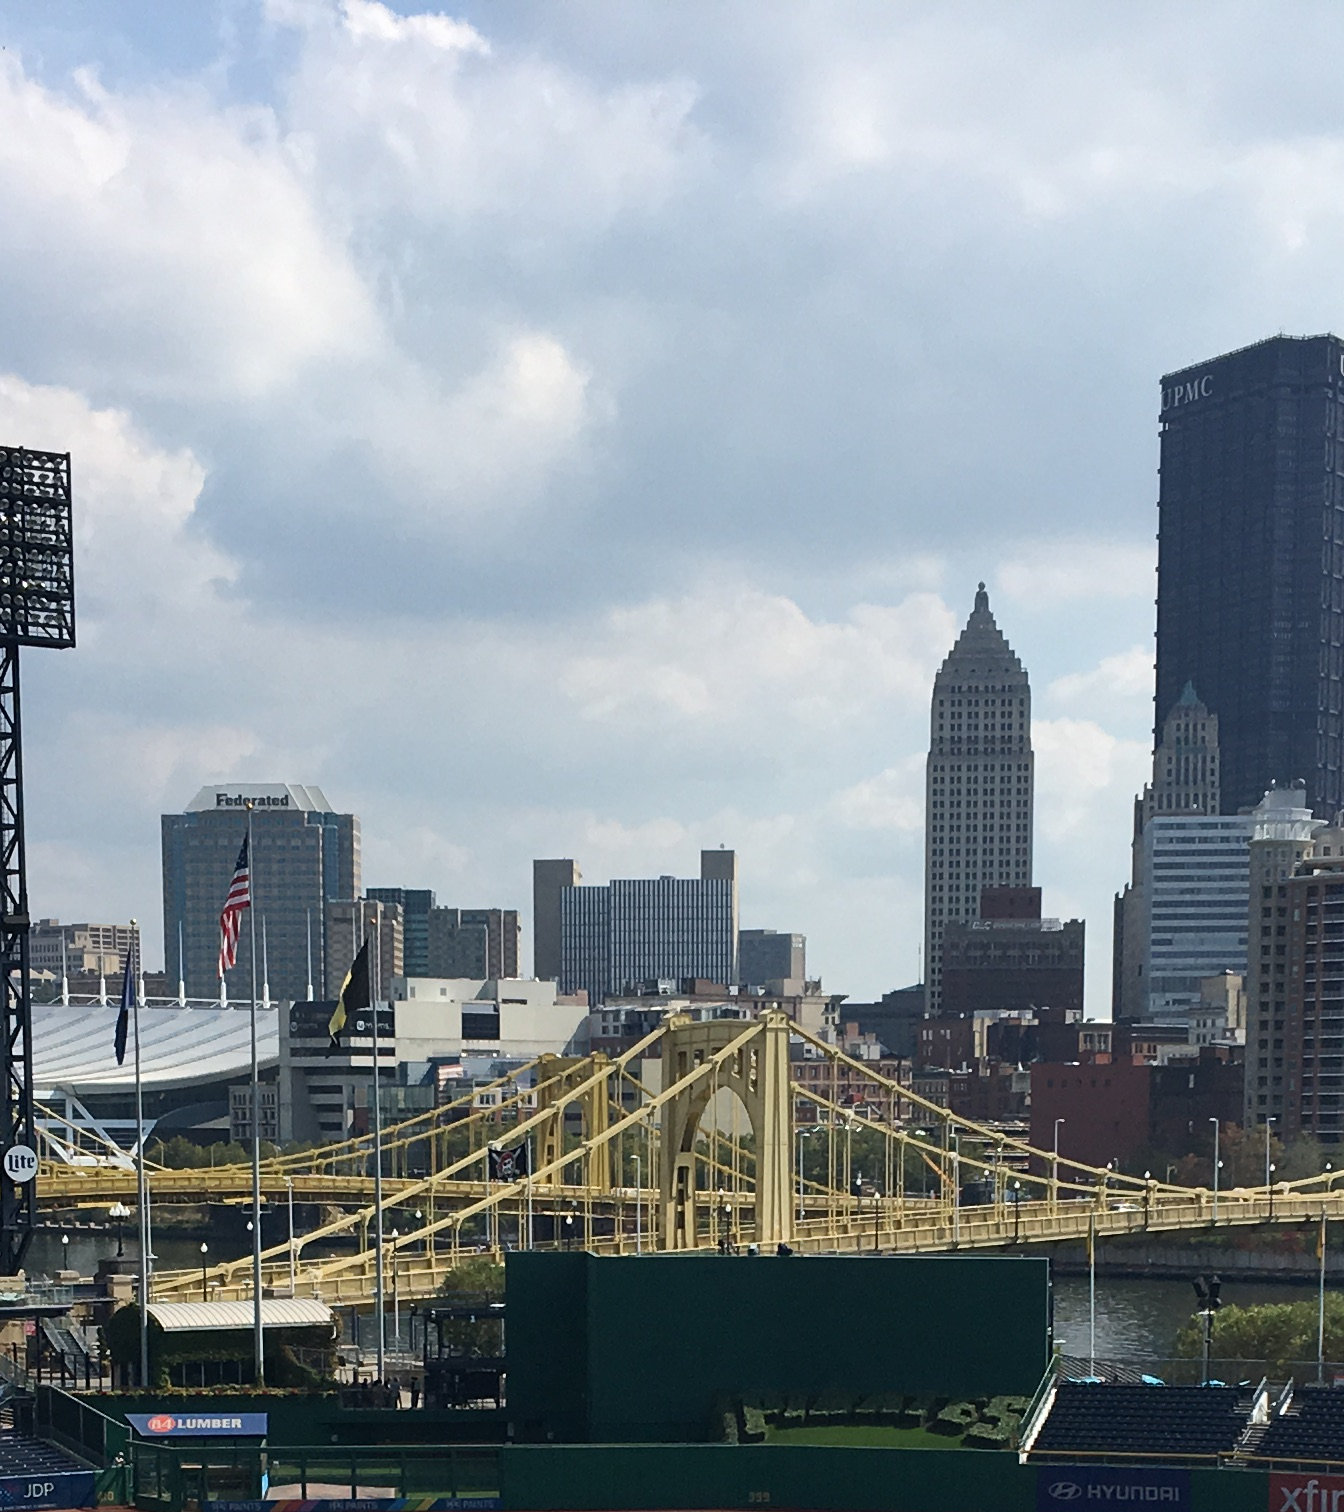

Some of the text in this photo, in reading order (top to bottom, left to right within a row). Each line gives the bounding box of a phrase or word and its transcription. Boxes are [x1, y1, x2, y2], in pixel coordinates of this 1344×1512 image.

[1161, 375, 1215, 412] UPMC
[216, 793, 289, 806] Federated
[7, 1154, 35, 1173] Lite
[177, 1418, 242, 1429] LUMBER
[23, 1483, 55, 1498] JDP
[1087, 1485, 1179, 1501] HYUNDAI
